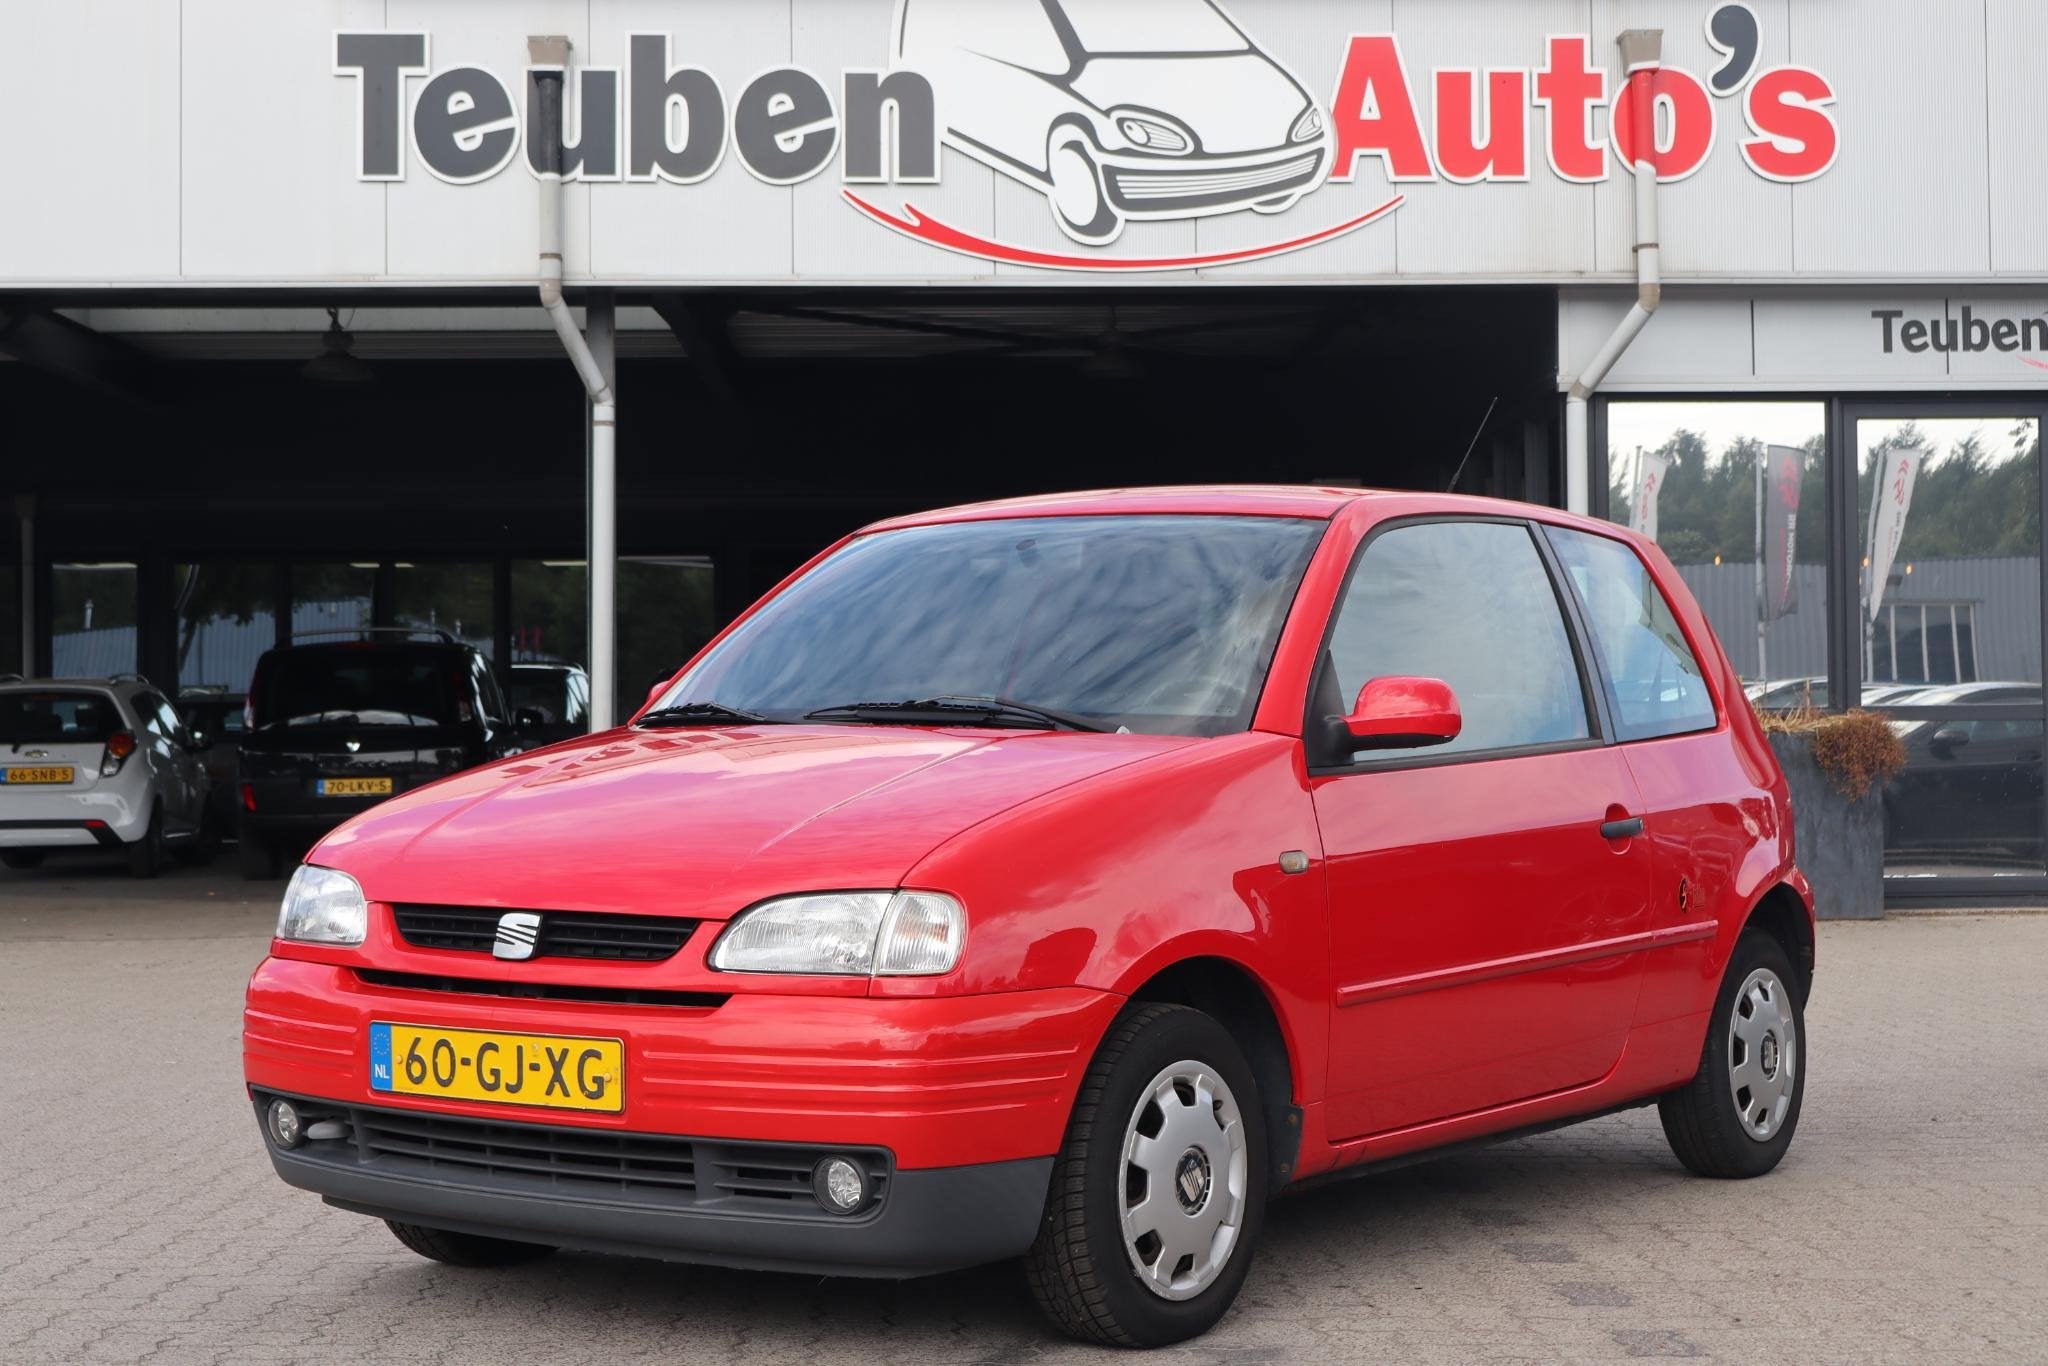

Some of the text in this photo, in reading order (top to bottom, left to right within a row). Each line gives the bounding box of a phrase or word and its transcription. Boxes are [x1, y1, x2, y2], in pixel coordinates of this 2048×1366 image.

[334, 31, 940, 183] Teuben
[1871, 305, 2048, 353] Teuben
[374, 1063, 390, 1080] NL
[405, 1037, 605, 1100] 60-GJ-XG
